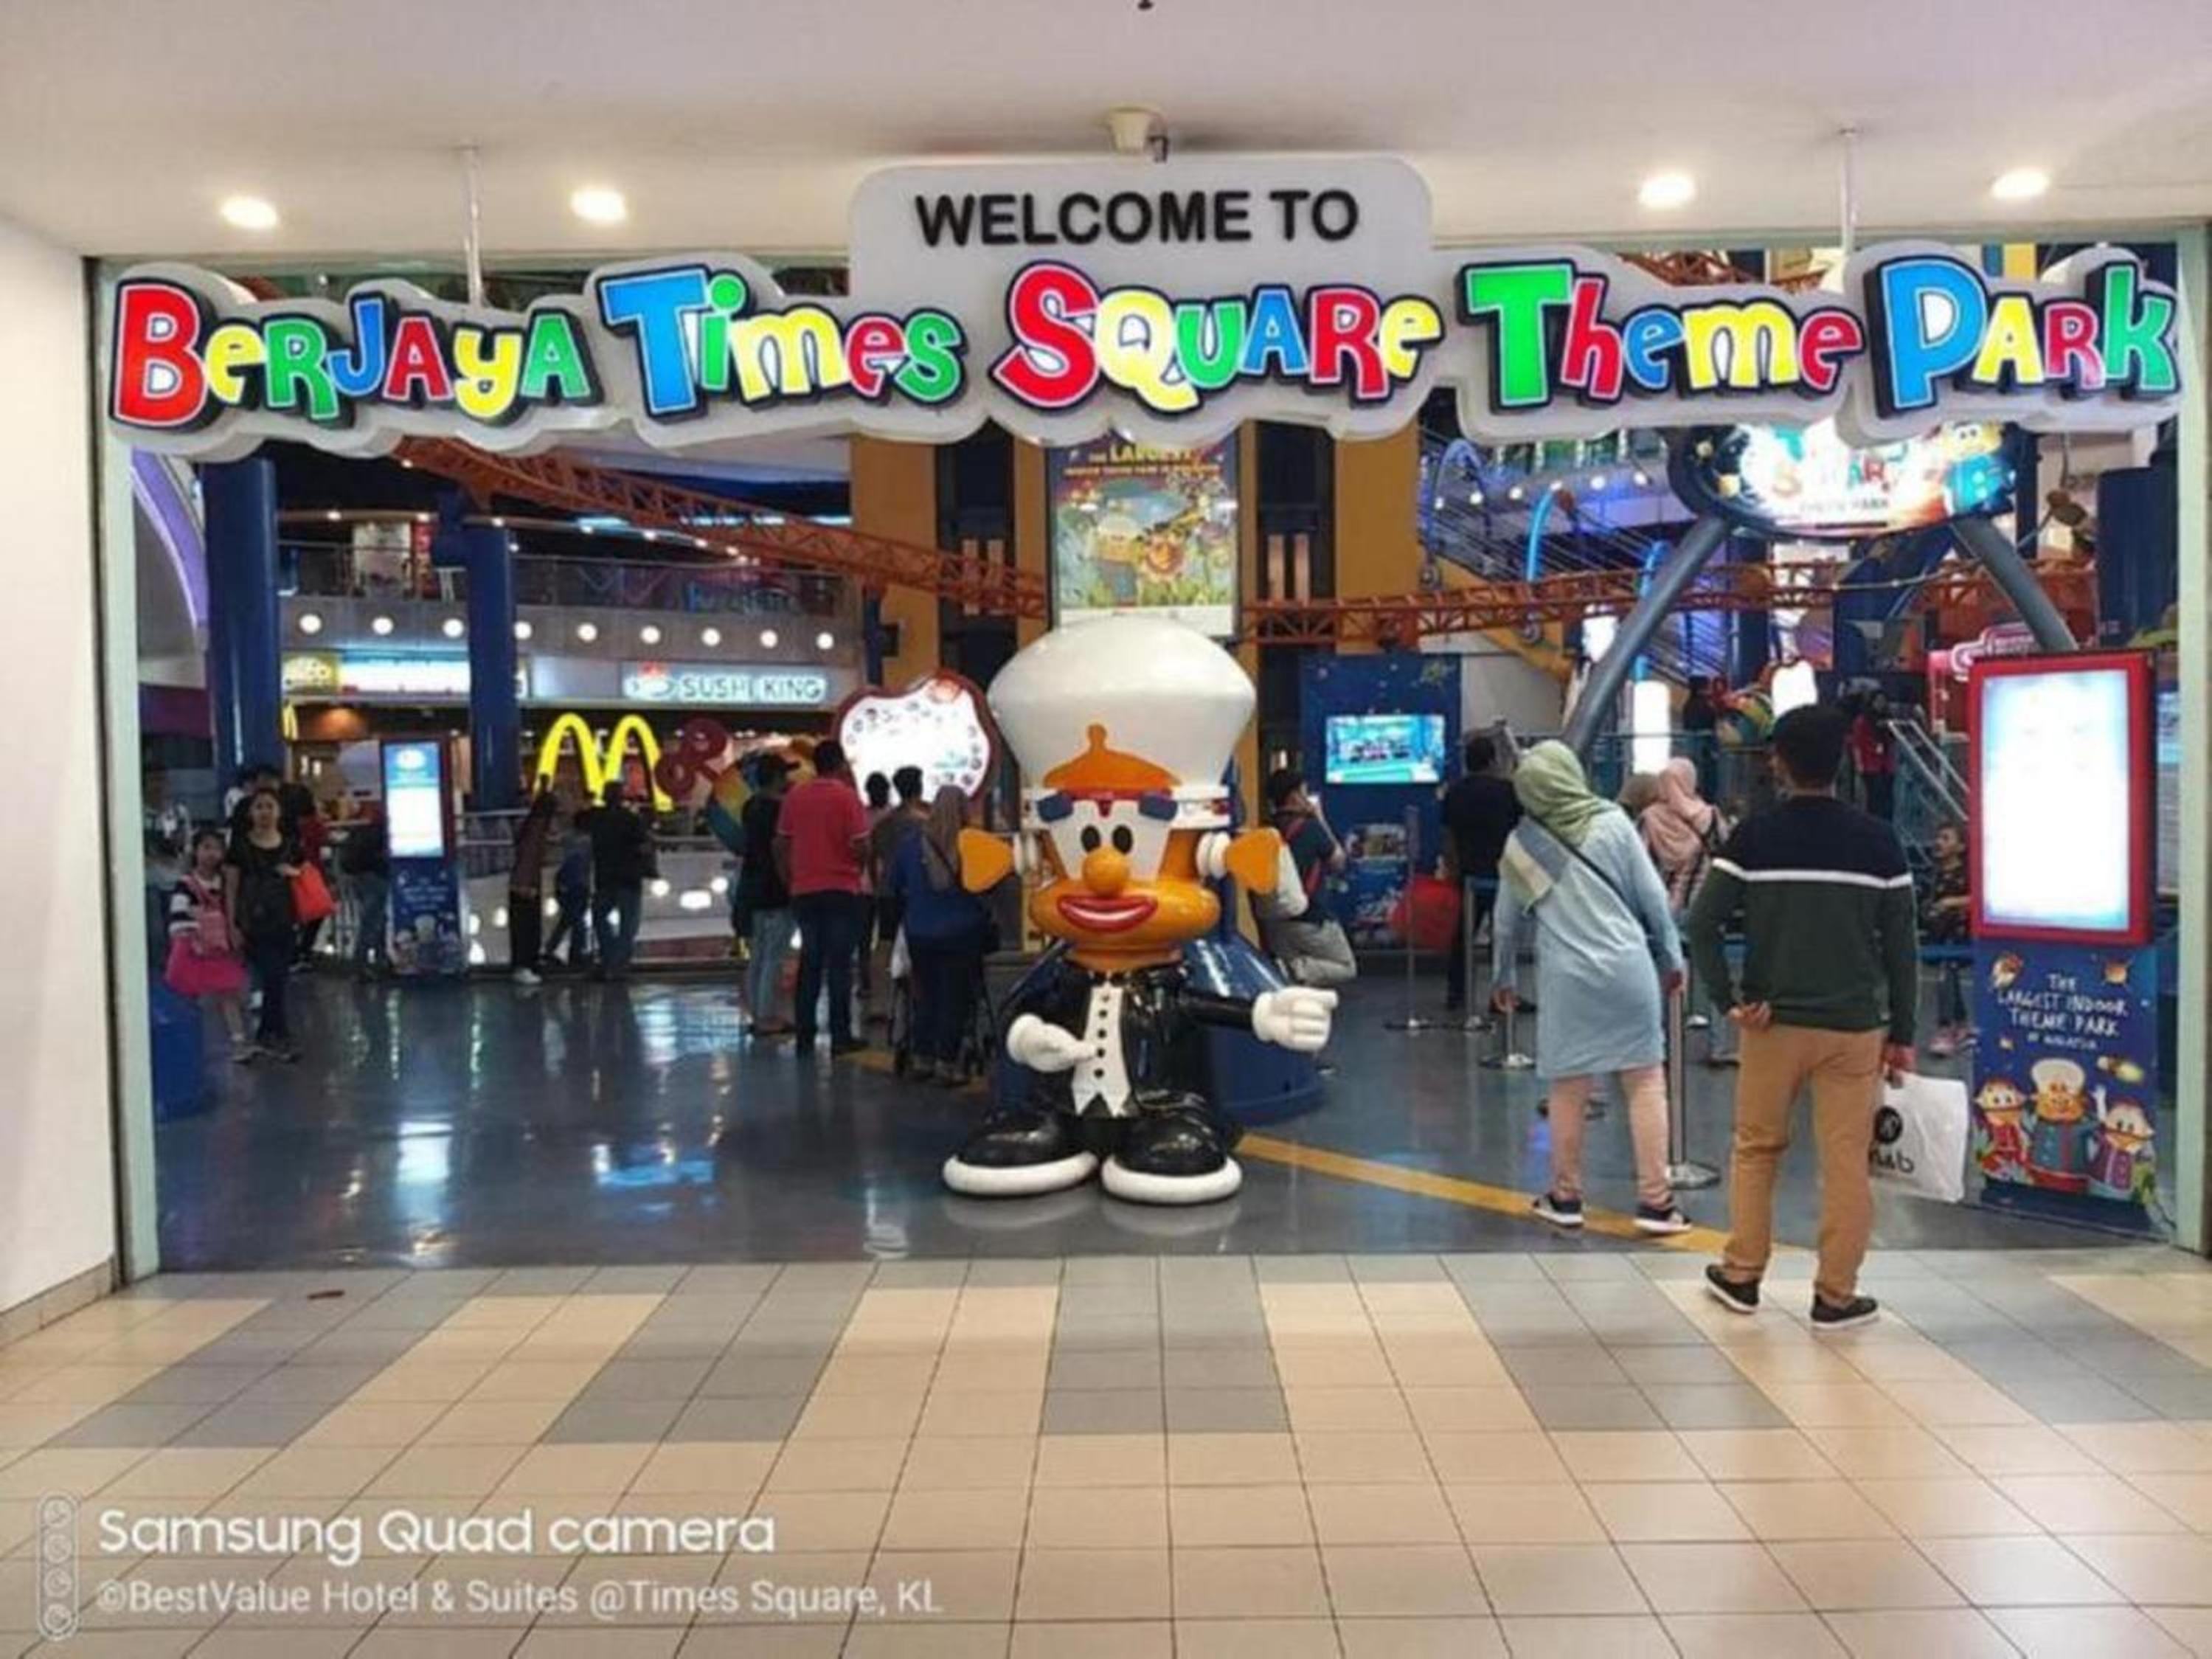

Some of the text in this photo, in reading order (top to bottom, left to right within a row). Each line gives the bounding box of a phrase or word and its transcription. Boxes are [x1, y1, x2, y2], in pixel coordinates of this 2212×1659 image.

[915, 189, 1359, 246] WELCOME TO
[681, 674, 824, 700] SUSHI KING
[2009, 1008, 2120, 1037] THEME PARK
